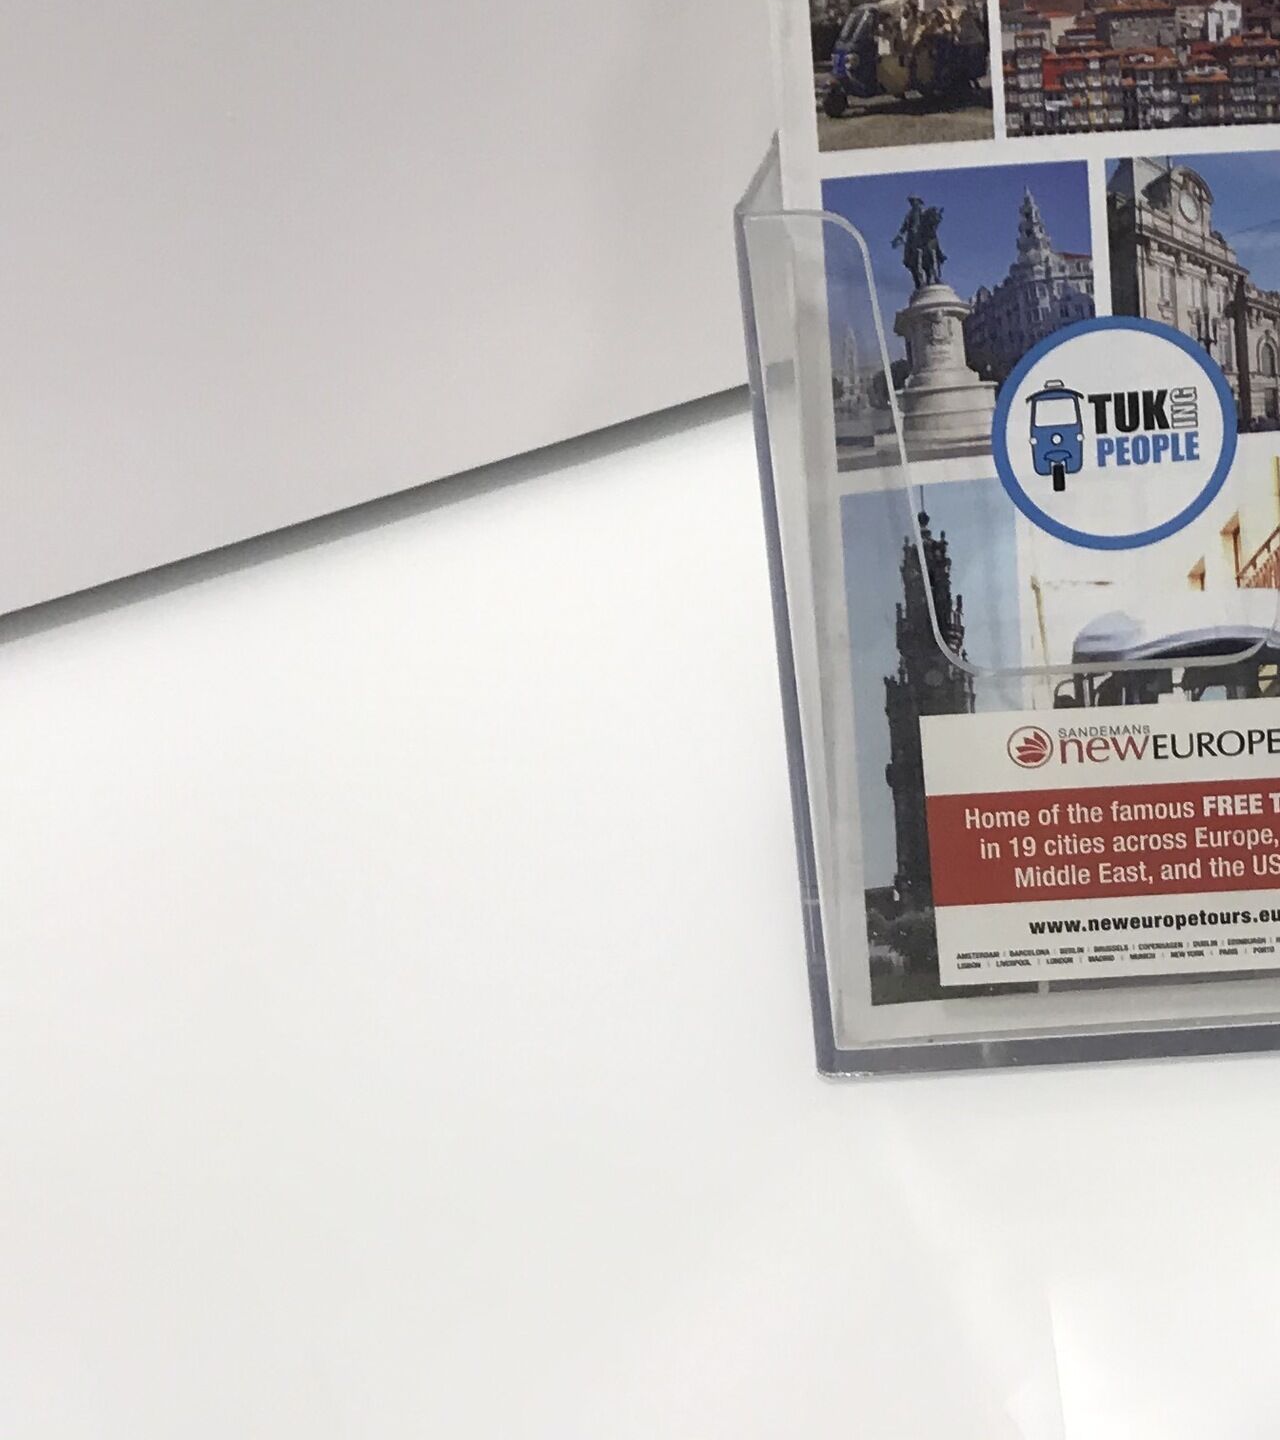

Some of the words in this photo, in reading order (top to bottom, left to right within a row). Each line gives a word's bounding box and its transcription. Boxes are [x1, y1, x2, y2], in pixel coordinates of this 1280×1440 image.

[1087, 389, 1170, 434] TUK
[1169, 386, 1198, 429] ING
[1096, 431, 1200, 467] PEOPLE
[1058, 725, 1150, 739] SANDEMANS
[965, 807, 1030, 830] Home
[1038, 803, 1060, 826] of
[1066, 802, 1103, 824] the
[1110, 799, 1196, 822] famous
[1202, 793, 1263, 817] FREE
[980, 838, 1000, 860] in
[1009, 835, 1036, 858] 19
[1044, 832, 1105, 856] cities
[1113, 830, 1187, 853] across
[1195, 826, 1279, 850] Europe,
[1014, 864, 1090, 888] Middle
[1099, 861, 1154, 885] East,
[1161, 858, 1201, 880] and
[1209, 856, 1244, 877] the
